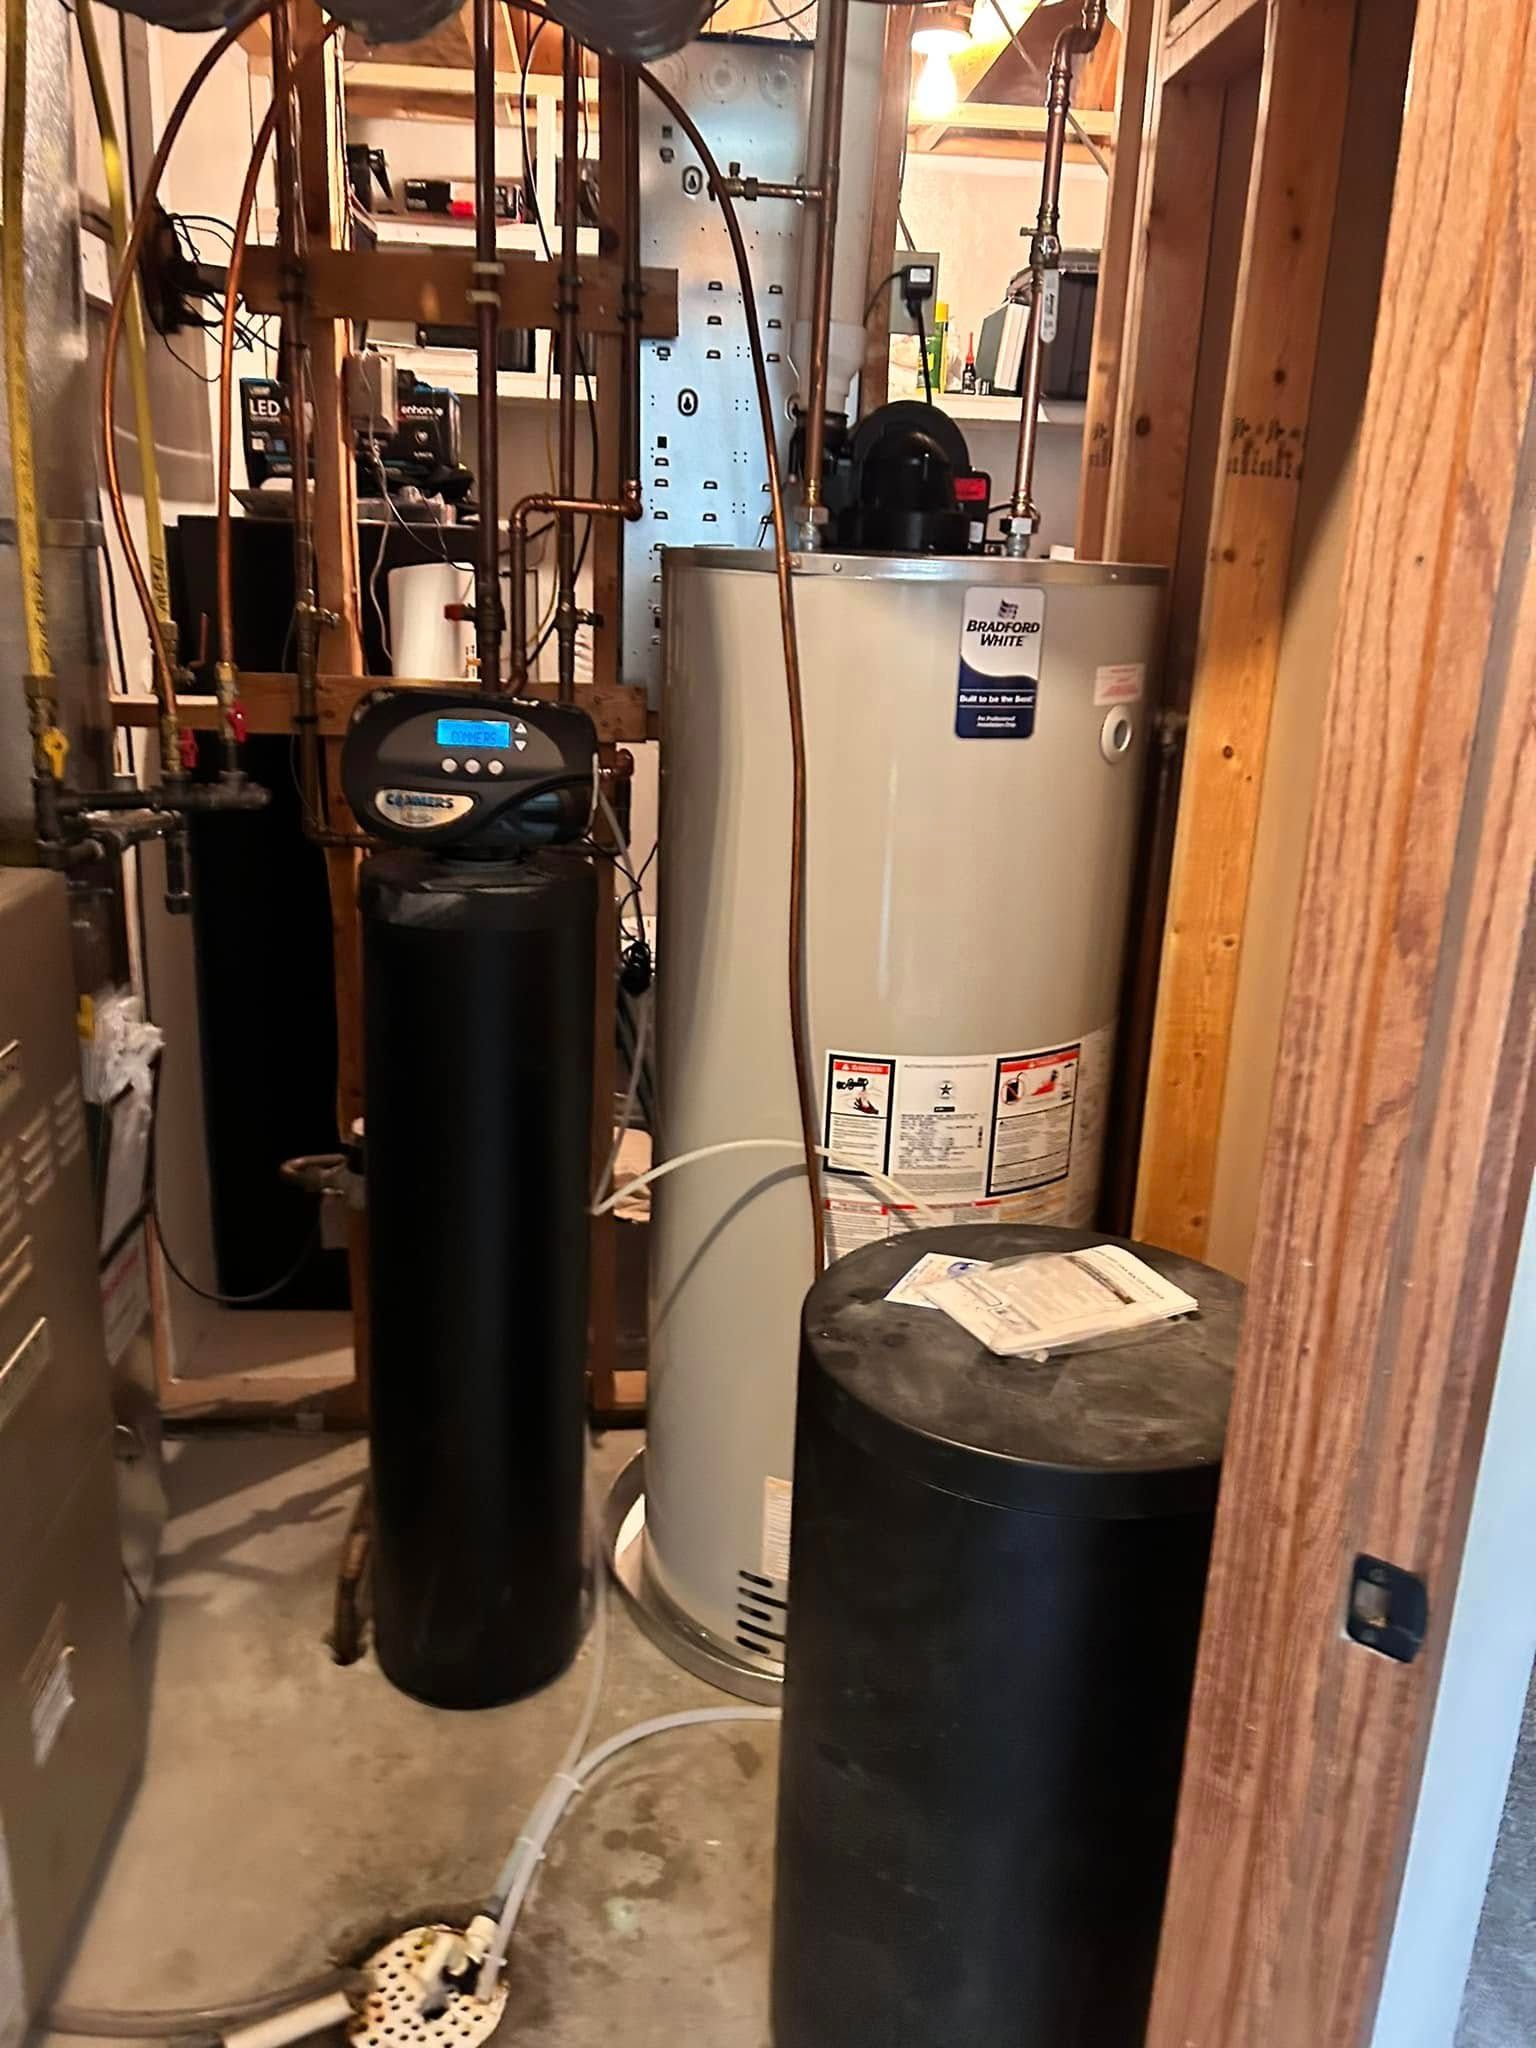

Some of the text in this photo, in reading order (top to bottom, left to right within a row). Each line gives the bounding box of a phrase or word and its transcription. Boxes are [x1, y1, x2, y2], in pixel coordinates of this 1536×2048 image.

[249, 398, 281, 416] LED
[967, 620, 1040, 633] BRADFORD
[980, 634, 1023, 647] WHITE
[988, 695, 999, 703] be
